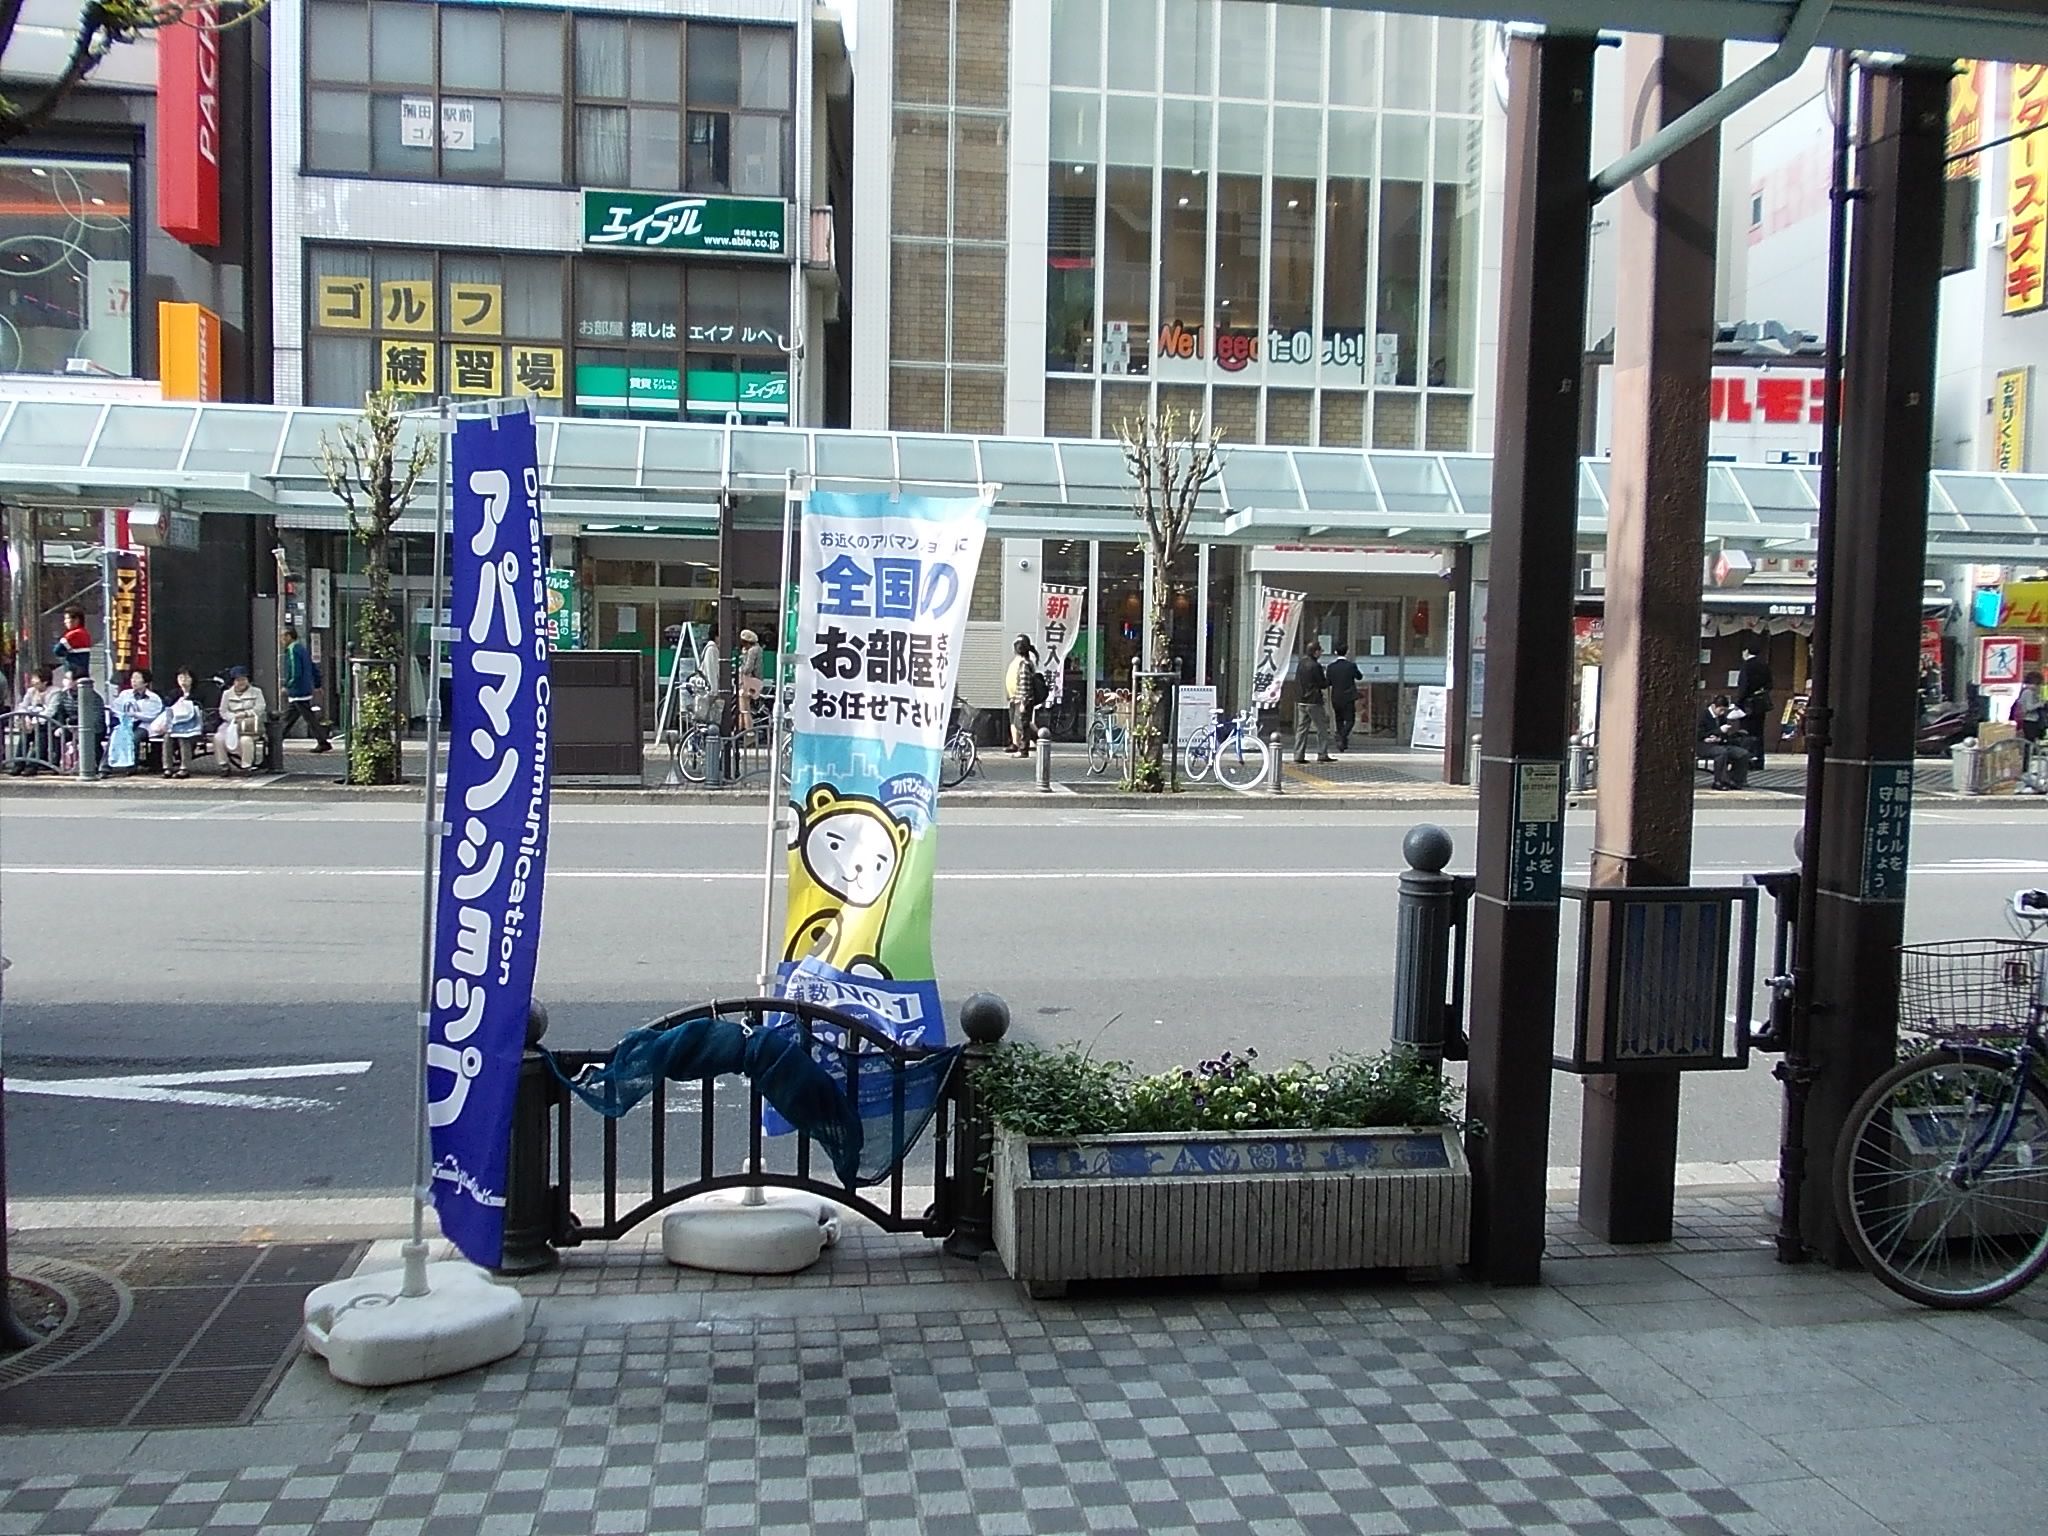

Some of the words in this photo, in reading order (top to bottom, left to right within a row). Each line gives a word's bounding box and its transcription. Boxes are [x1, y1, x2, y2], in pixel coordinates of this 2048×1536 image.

[589, 199, 707, 245] エイブル
[704, 234, 780, 250] www.able.co.jp
[326, 281, 494, 327] ゴルフ
[386, 346, 556, 391] 練習場
[740, 379, 787, 399] エイブル
[523, 467, 547, 661] Dramatic
[815, 554, 960, 622] 全国の
[115, 568, 137, 671] HIROKI
[1253, 600, 1289, 693] 新台入替
[810, 626, 935, 688] お部屋
[936, 633, 949, 690] さがし
[809, 689, 945, 731] お任せ下さい!
[427, 469, 521, 1127] アパマンショップ
[498, 675, 551, 985] Communication
[1890, 769, 1910, 871] 駐輪ルールを
[1522, 823, 1538, 892] ましょう
[1874, 786, 1894, 888] 守りましょう
[831, 981, 910, 1020] No.1
